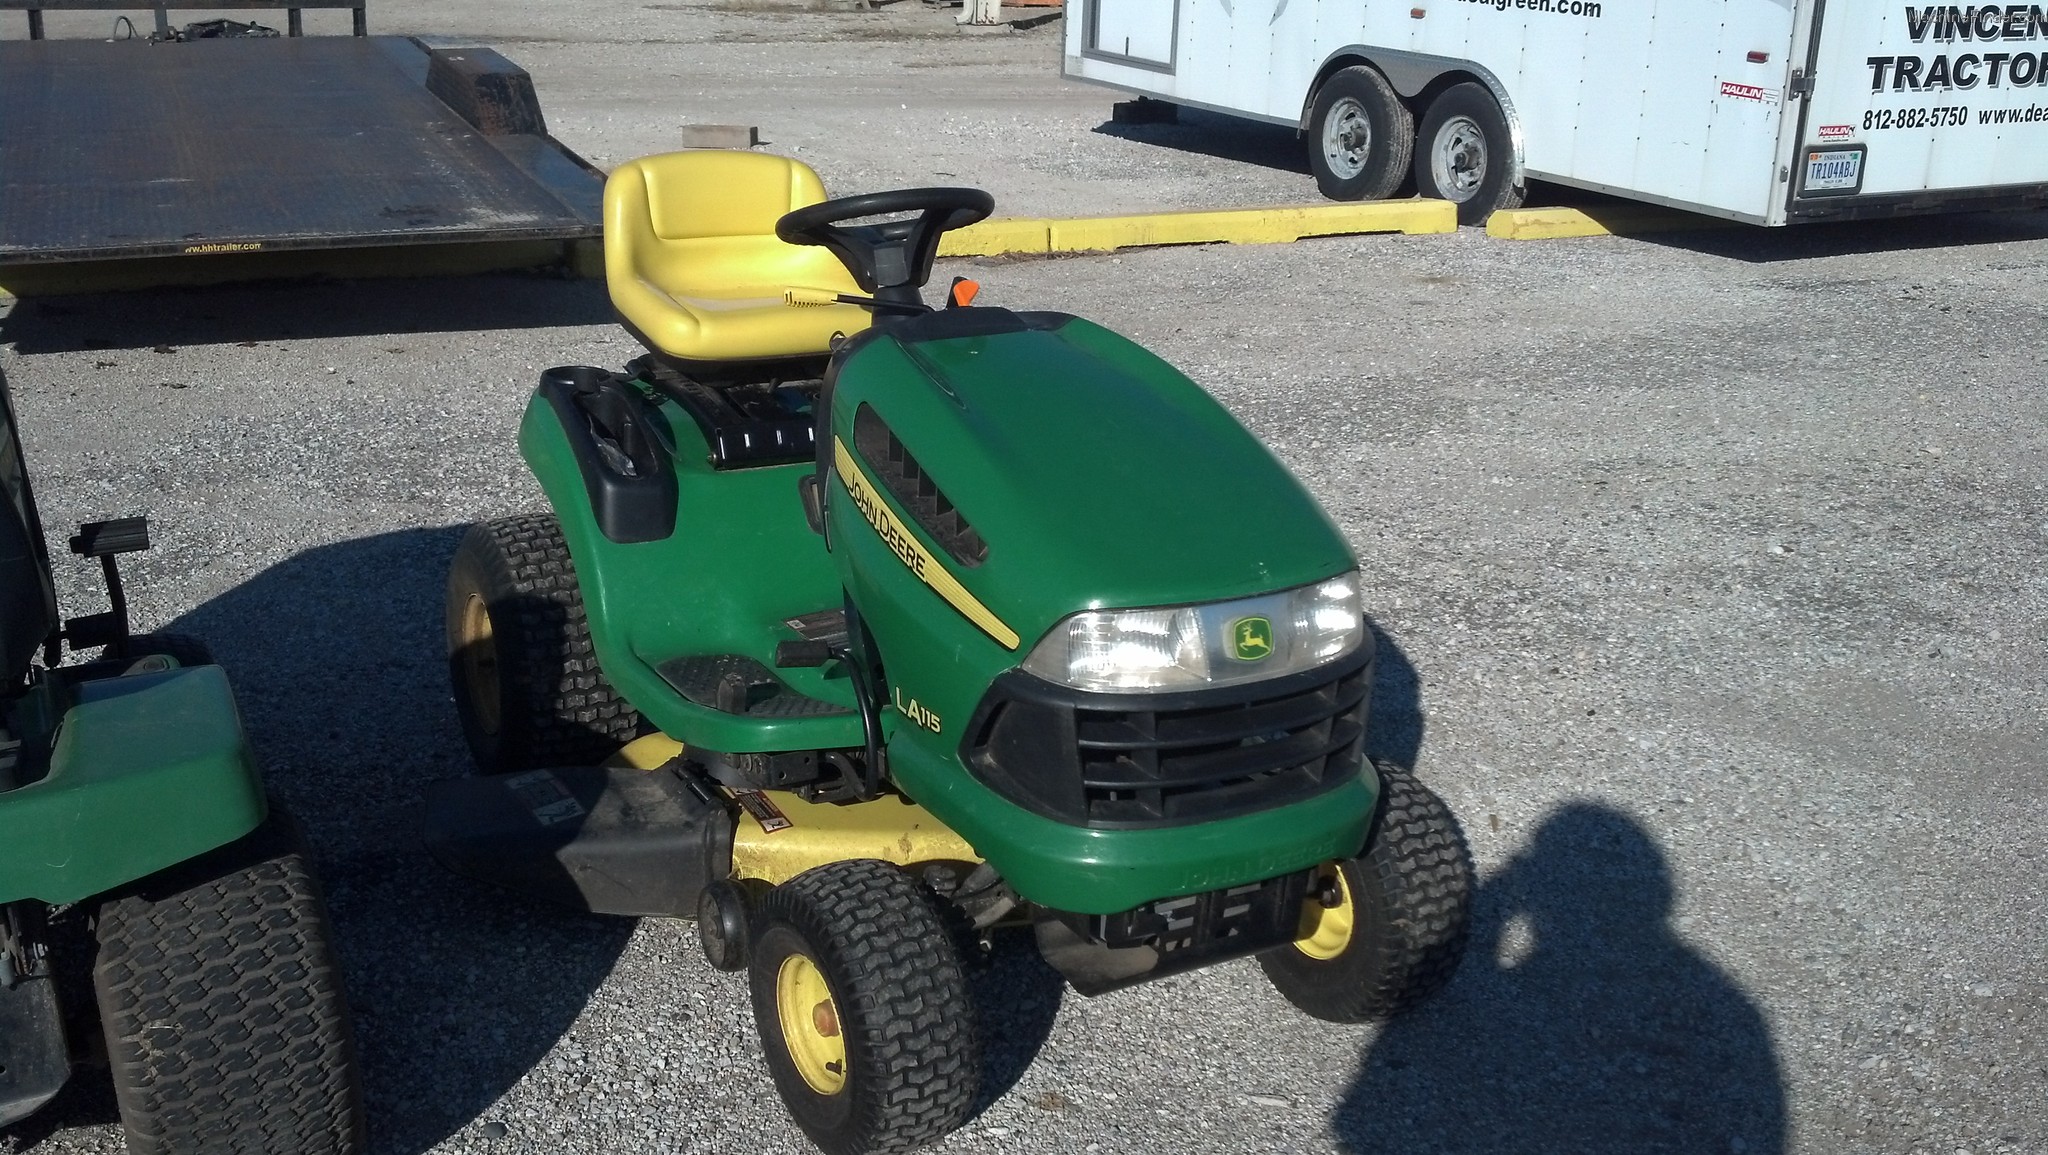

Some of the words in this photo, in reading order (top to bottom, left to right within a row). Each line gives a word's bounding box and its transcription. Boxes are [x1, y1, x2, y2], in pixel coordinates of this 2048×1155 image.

[1457, 0, 1602, 18] green.com
[1721, 83, 1763, 99] HAULIN
[1862, 106, 1968, 130] 812-882-5750
[1811, 161, 1857, 180] TR104ABJ
[849, 472, 877, 529] JOHN
[879, 509, 927, 582] DEERE
[895, 686, 941, 733] LA115
